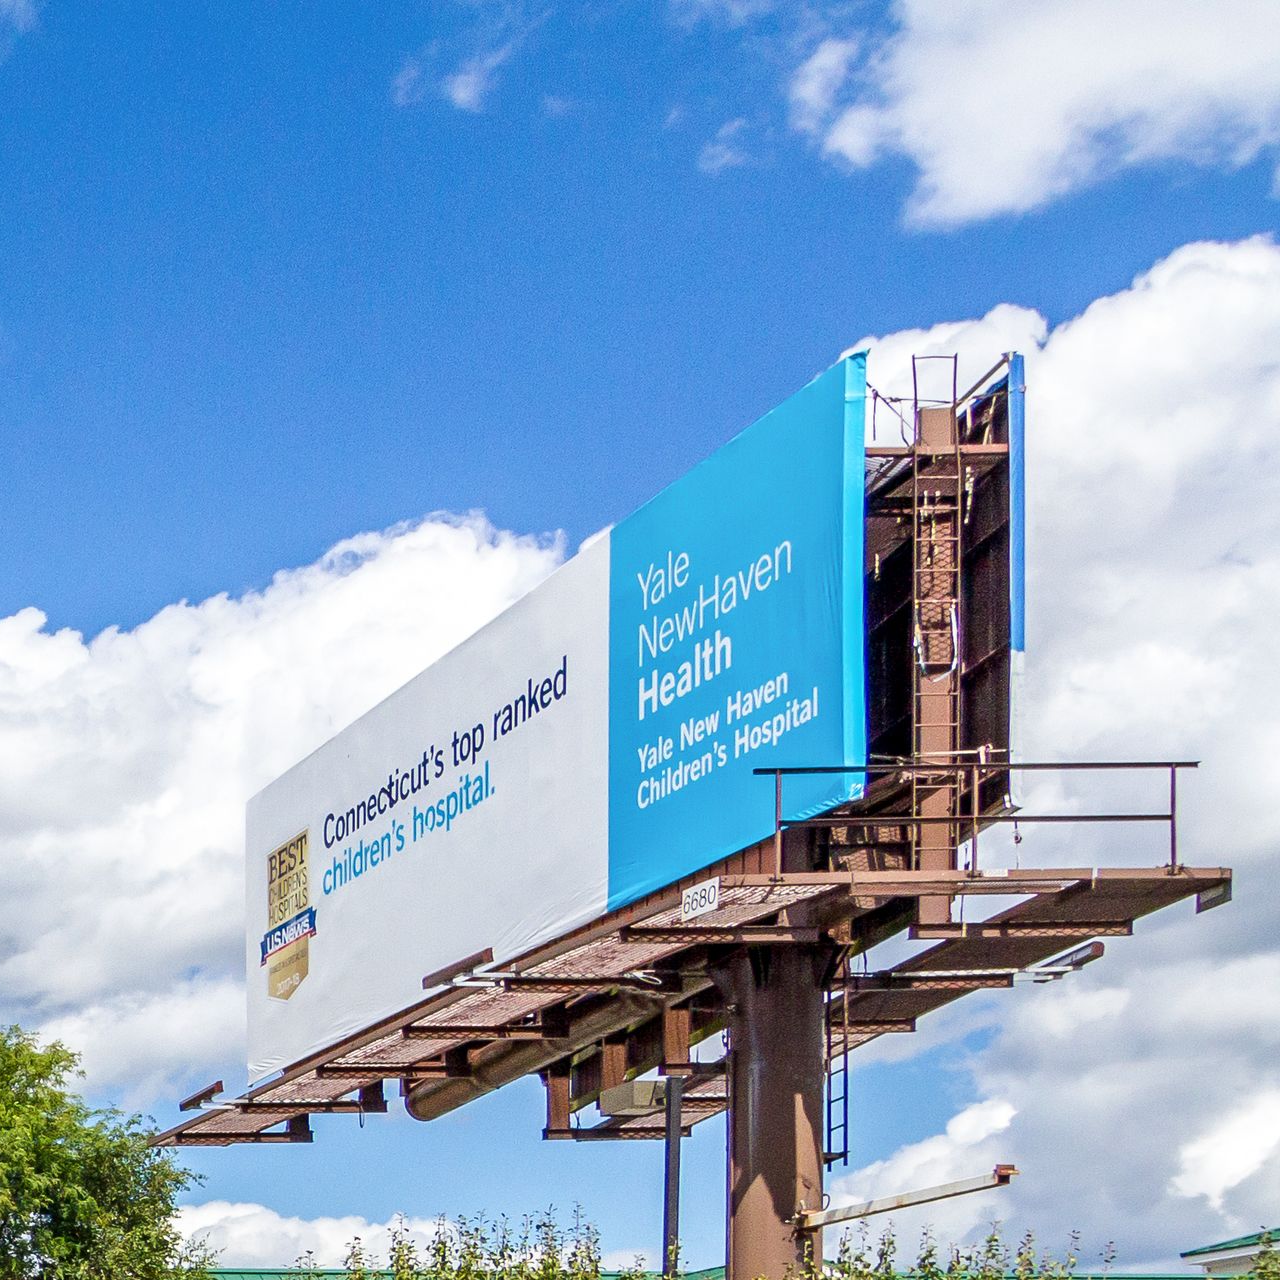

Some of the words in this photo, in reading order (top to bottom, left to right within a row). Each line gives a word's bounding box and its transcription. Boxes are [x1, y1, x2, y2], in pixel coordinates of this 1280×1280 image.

[637, 550, 690, 610] Yale
[637, 736, 674, 773] Yale
[680, 710, 720, 751] New
[726, 672, 789, 725] Haven
[638, 630, 732, 721] Health
[323, 744, 444, 849] Connecticut's
[451, 722, 485, 766] top
[493, 654, 568, 741] ranked
[637, 741, 728, 809] Children's
[734, 686, 819, 759] Hospital
[268, 834, 307, 885] BEST
[322, 819, 405, 896] children's
[412, 759, 496, 843] hospital.
[683, 884, 717, 914] 6680
